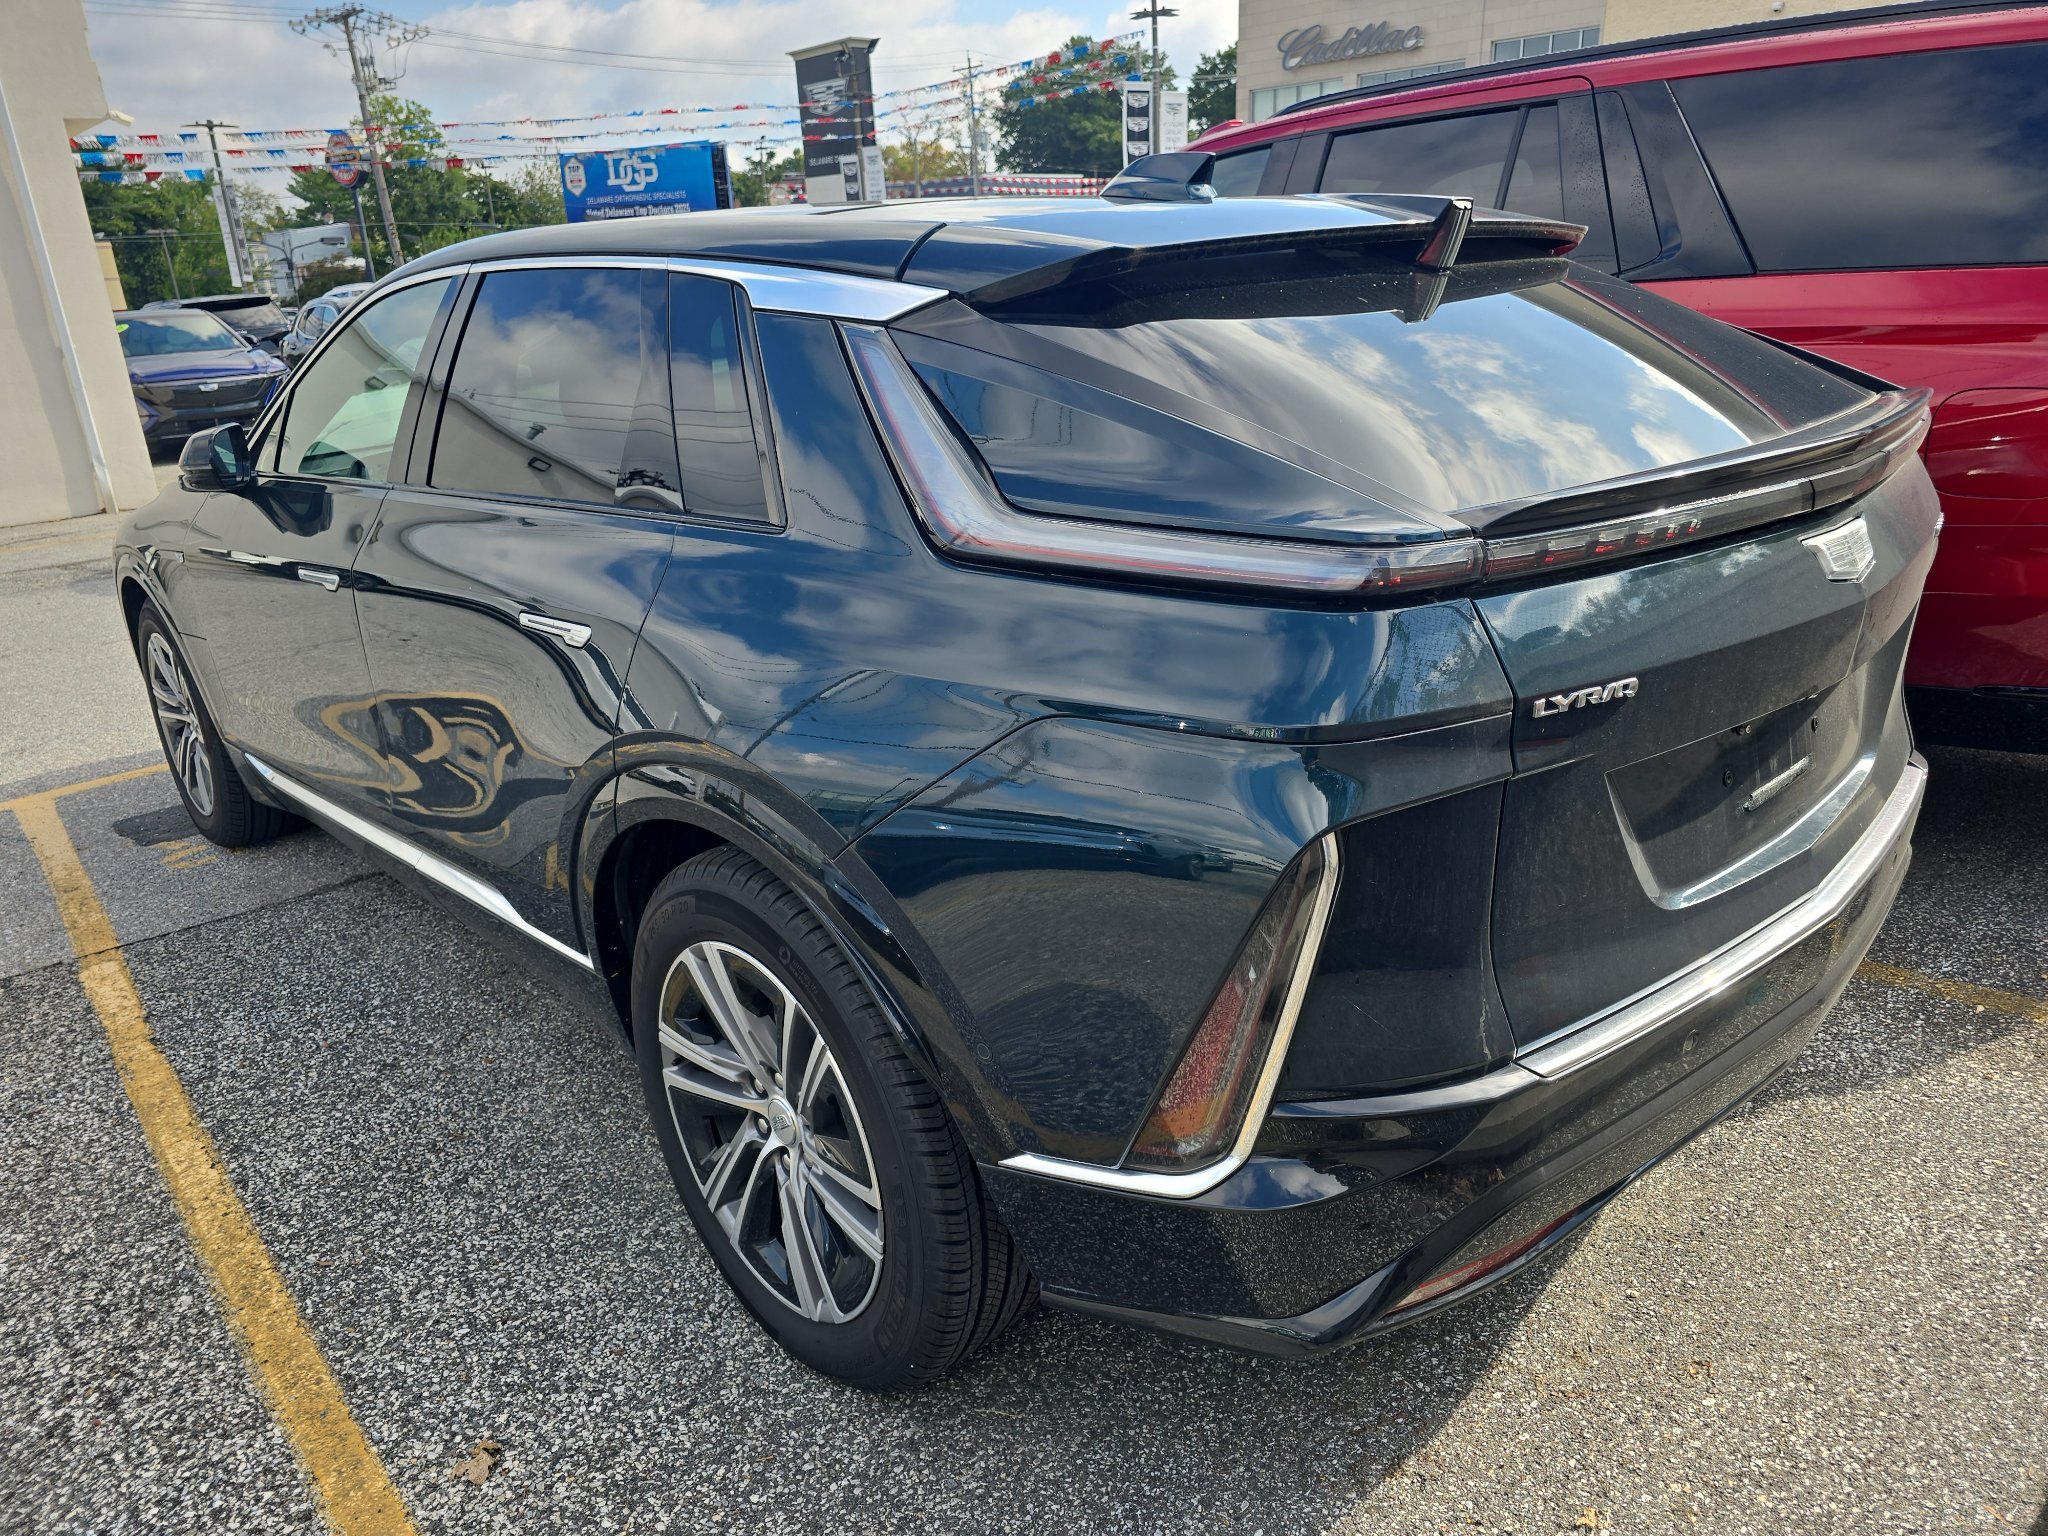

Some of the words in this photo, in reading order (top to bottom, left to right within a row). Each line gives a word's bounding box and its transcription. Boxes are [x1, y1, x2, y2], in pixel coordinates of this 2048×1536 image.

[1277, 20, 1425, 71] Cadillac
[809, 155, 834, 167] DELAWARE
[586, 195, 614, 205] DELAWARE
[653, 190, 687, 200] SPECIALISTS
[605, 205, 635, 217] Delaware
[635, 204, 648, 216] Top
[648, 203, 674, 216] Doctors
